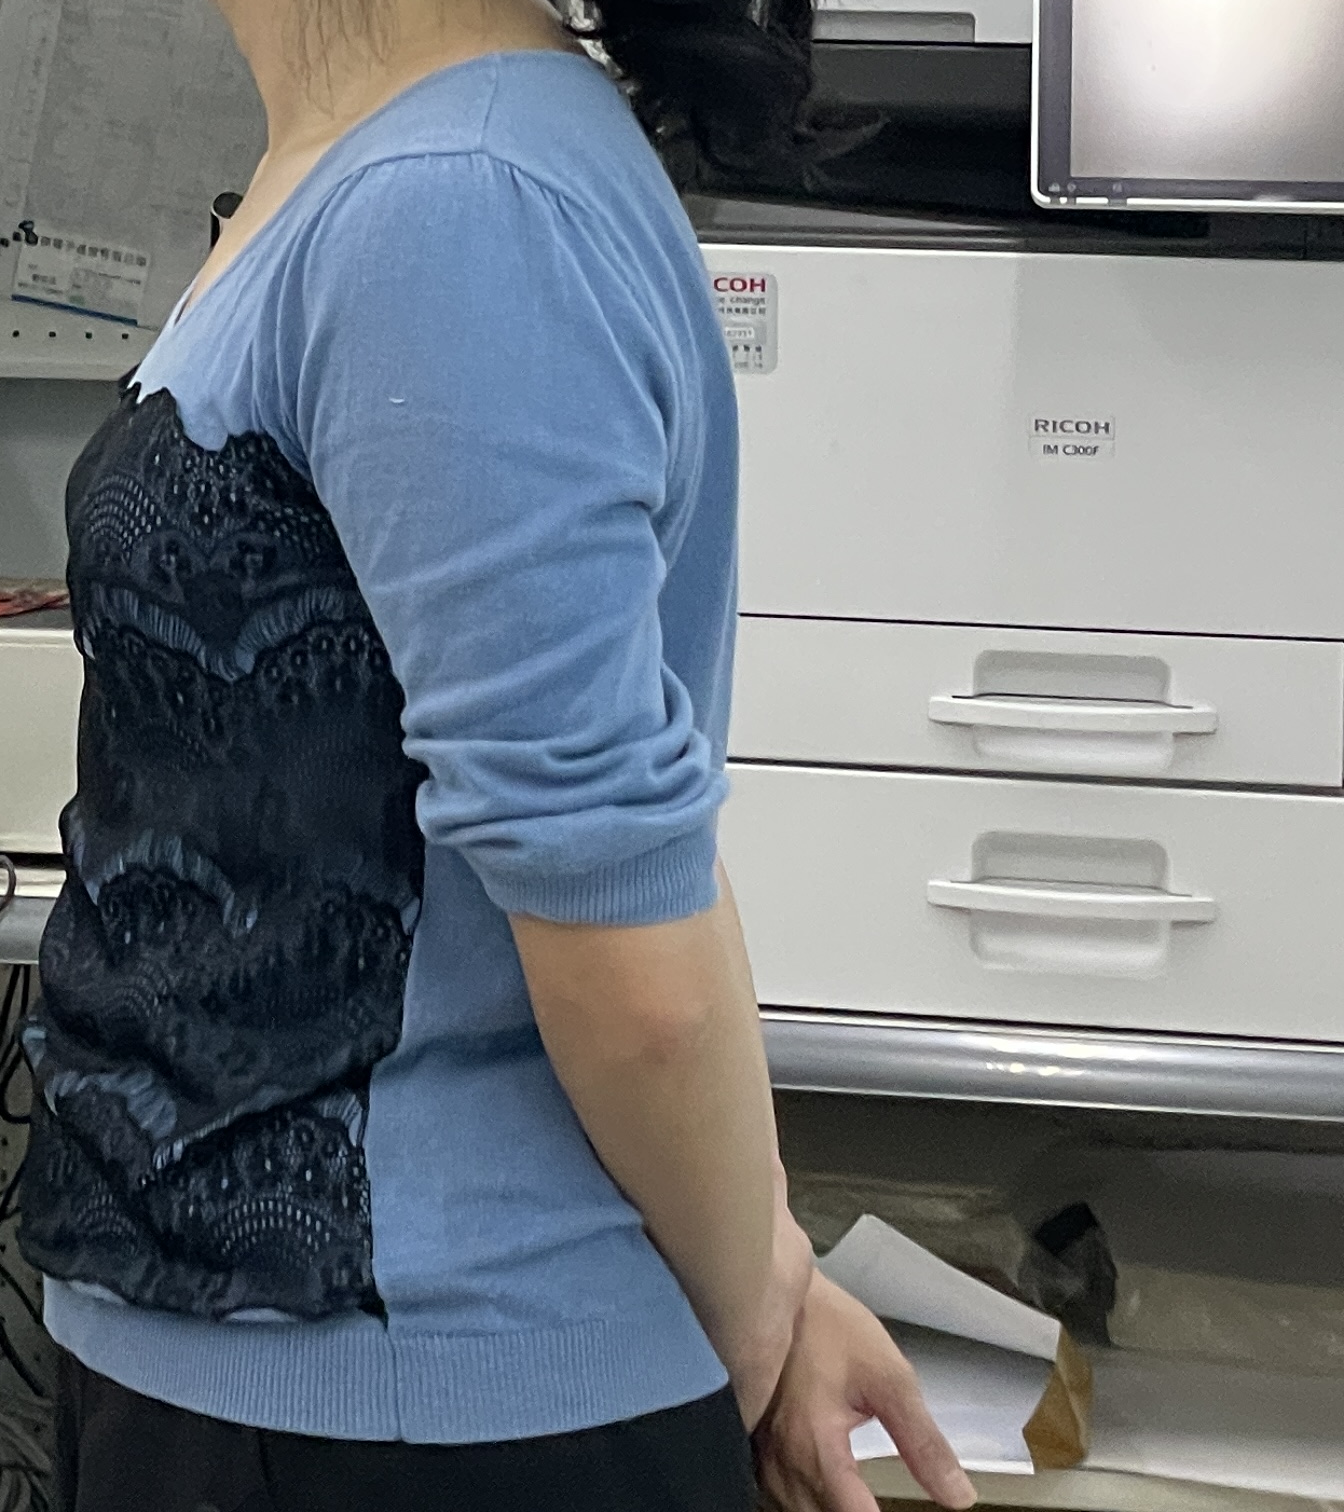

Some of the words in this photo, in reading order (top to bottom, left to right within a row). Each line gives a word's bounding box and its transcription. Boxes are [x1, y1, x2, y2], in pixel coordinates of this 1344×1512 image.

[713, 277, 766, 292] COH
[1034, 419, 1111, 434] RICOH
[1043, 444, 1059, 455] IM
[1063, 444, 1100, 456] C300F
